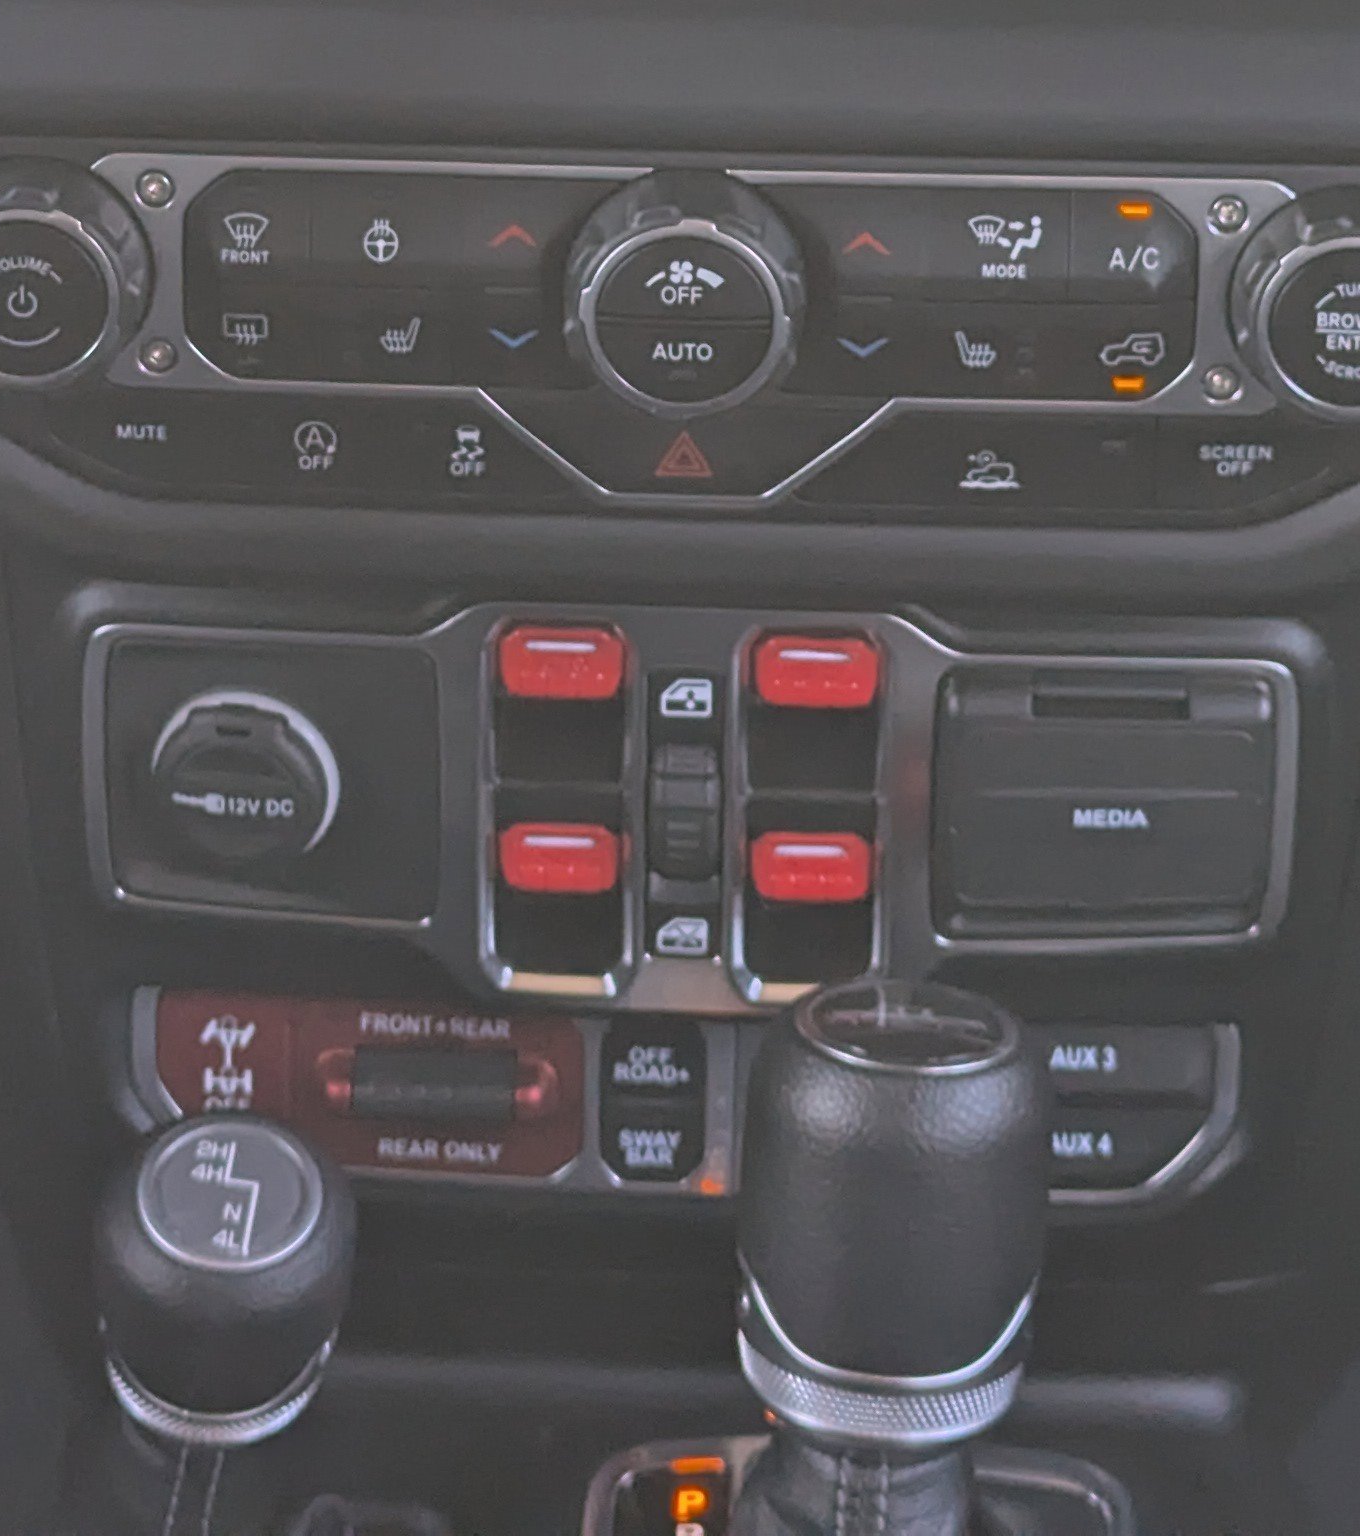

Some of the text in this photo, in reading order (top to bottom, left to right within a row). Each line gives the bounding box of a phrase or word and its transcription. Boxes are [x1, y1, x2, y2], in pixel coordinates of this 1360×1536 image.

[220, 249, 269, 264] FRONT
[1109, 247, 1160, 271] A/C
[981, 264, 1027, 279] MODE
[660, 285, 703, 306] OFF
[651, 342, 713, 362] AUTO
[115, 424, 168, 441] MUTE
[298, 454, 334, 470] OFF
[1199, 444, 1273, 461] SCREEN
[449, 461, 486, 476] OFF
[1215, 460, 1253, 477] OFF
[228, 798, 294, 817] 12V DC
[1072, 808, 1151, 829] MEDIA
[628, 1044, 672, 1065] OFF
[1048, 1044, 1118, 1073] AUX 3
[619, 1129, 681, 1149] SWAY
[1096, 1131, 1114, 1159] 4
[378, 1137, 502, 1164] REAR ONLY
[625, 1146, 674, 1167] BAR
[190, 1164, 224, 1184] 4H
[223, 1202, 242, 1223] N
[212, 1229, 241, 1253] 4L
[677, 1490, 706, 1523] P
